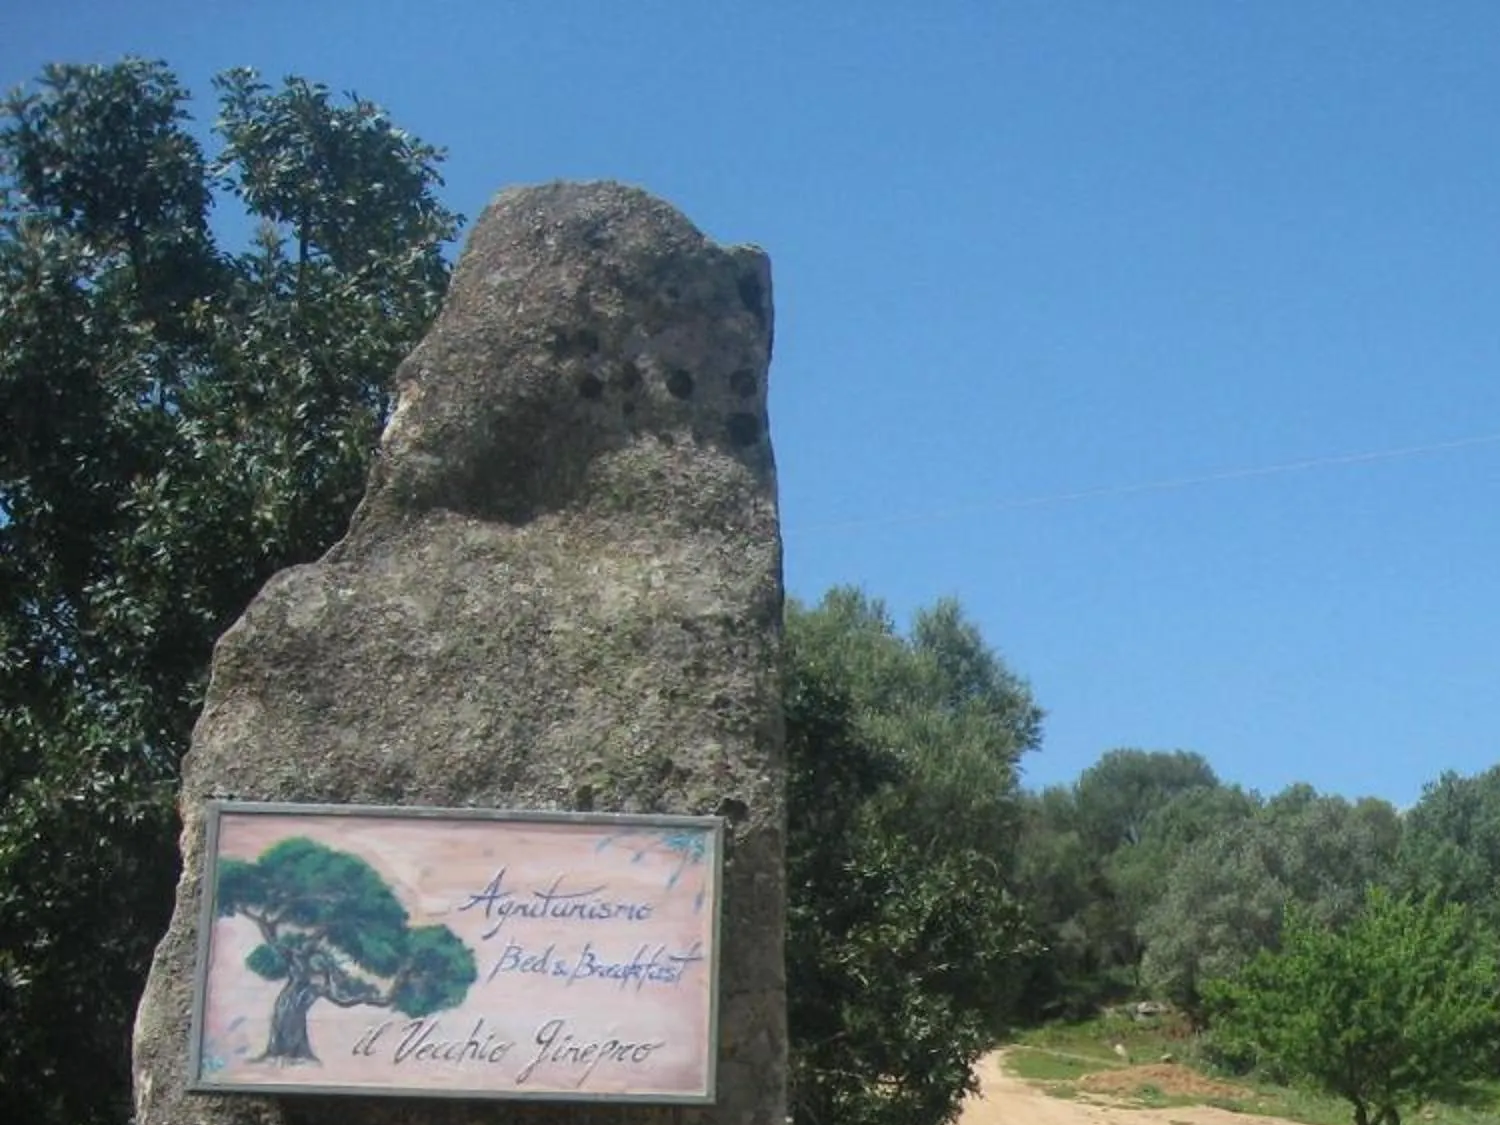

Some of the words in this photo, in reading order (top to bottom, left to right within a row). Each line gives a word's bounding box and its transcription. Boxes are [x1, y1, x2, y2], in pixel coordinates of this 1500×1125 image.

[487, 941, 553, 983] Bed
[570, 943, 704, 992] Breakfast
[394, 1018, 514, 1067] Vecchio
[517, 1019, 665, 1085] Ginepro
